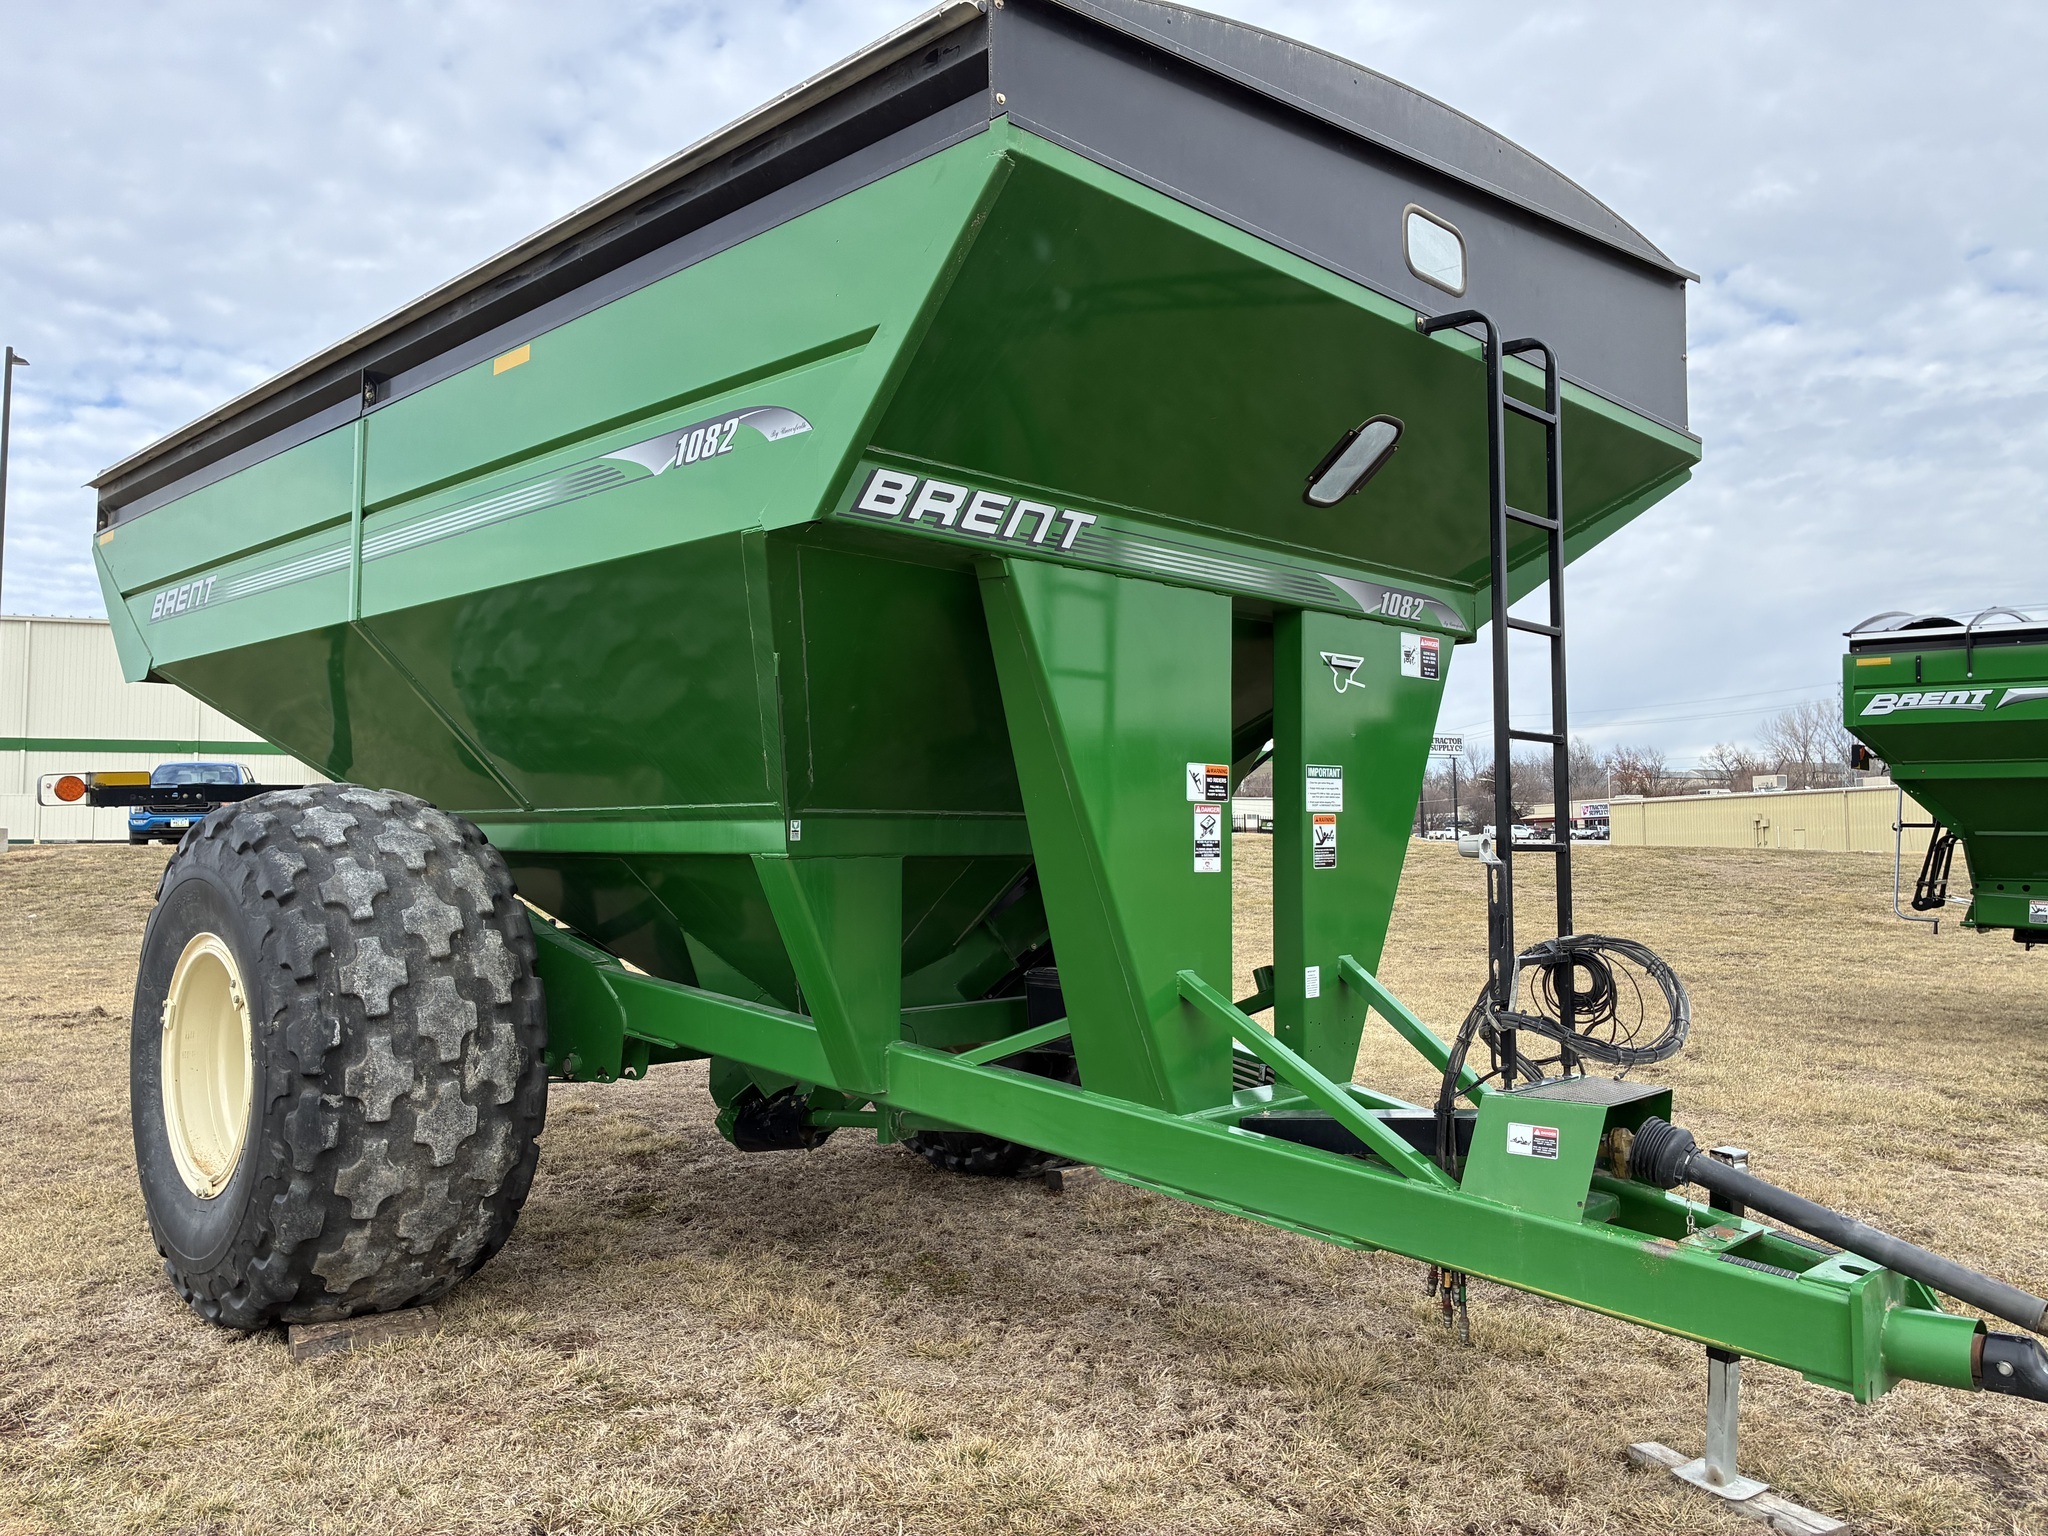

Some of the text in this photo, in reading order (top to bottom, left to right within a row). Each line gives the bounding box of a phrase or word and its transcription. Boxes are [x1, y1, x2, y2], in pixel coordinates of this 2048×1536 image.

[674, 417, 739, 468] 1082
[853, 467, 1098, 549] BRENT
[150, 574, 218, 621] BRENT
[1381, 591, 1425, 621] 1082
[1859, 689, 1994, 716] BRENT
[1308, 767, 1340, 777] IMPORTANT
